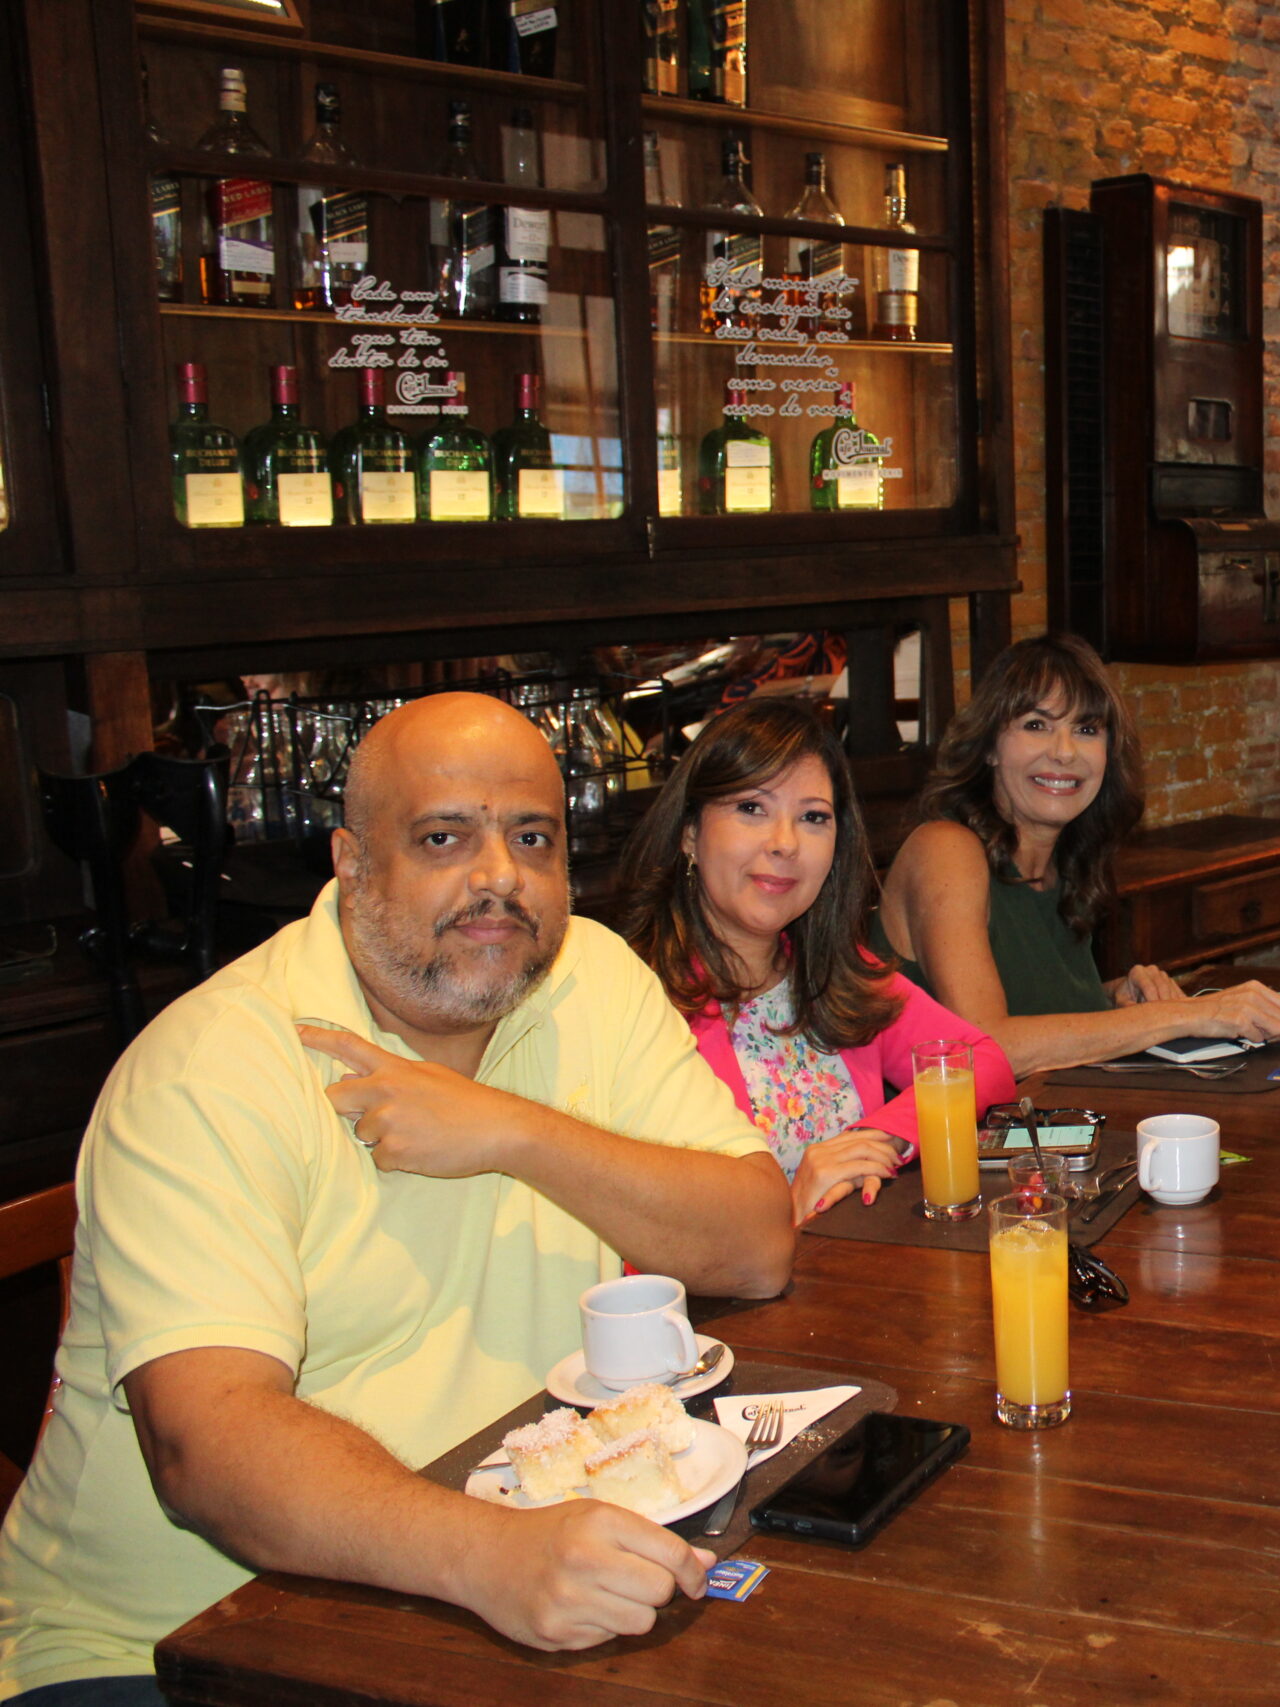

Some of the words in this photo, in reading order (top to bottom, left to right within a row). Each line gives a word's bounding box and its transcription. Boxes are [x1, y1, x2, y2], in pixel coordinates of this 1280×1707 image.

[706, 257, 757, 287] Todo
[762, 275, 859, 294] momento
[351, 275, 397, 301] Cada
[400, 291, 439, 301] um
[711, 290, 735, 313] de
[335, 304, 440, 323] transborda
[400, 327, 441, 345] tem
[715, 325, 753, 340] sua
[328, 347, 394, 367] dentro
[397, 348, 421, 367] de
[736, 342, 833, 366] demandar
[727, 377, 776, 391] uma
[722, 402, 776, 416] nova
[779, 394, 802, 416] de
